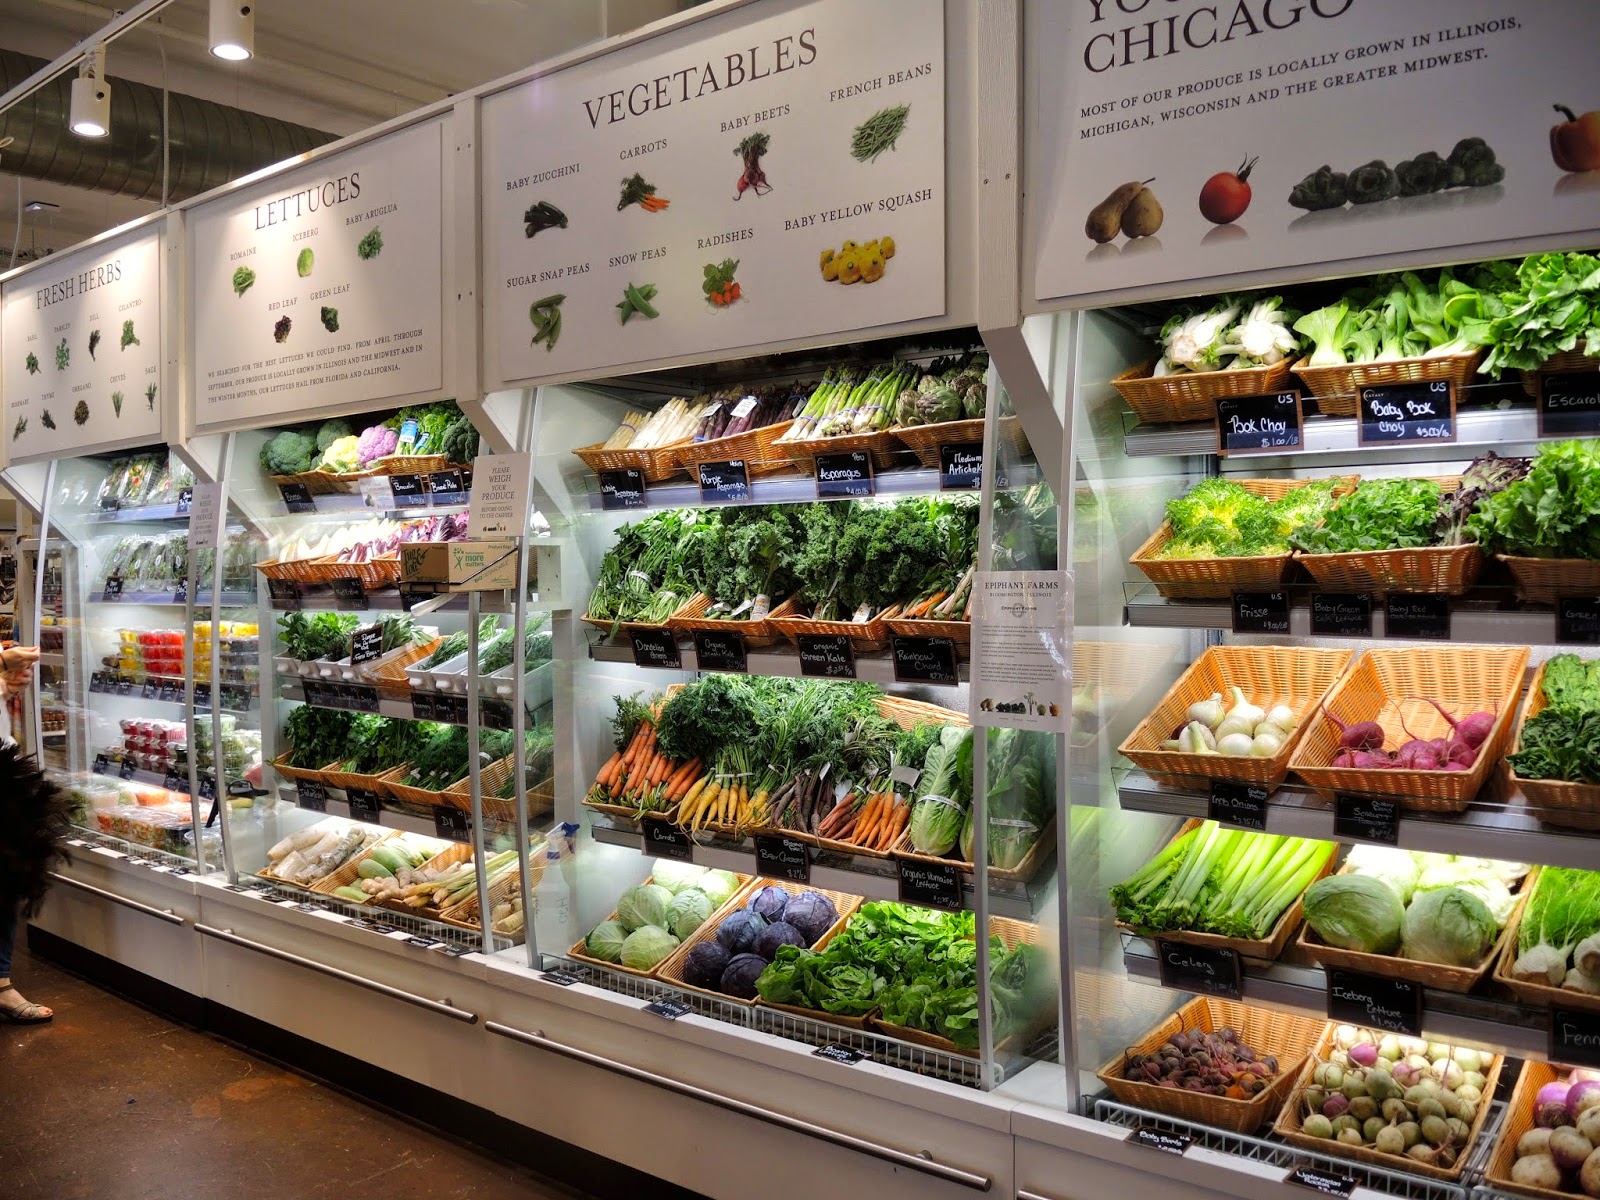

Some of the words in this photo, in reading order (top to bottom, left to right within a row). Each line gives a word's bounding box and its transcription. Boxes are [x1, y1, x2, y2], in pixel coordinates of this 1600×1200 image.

[1080, 101, 1117, 118] MOST
[1121, 96, 1139, 109] OF
[1143, 89, 1172, 104] OUR
[1177, 73, 1243, 97] PRODUCE
[1249, 70, 1262, 81] IS
[1268, 52, 1340, 76] LOCALLY
[1345, 39, 1405, 61] GROWN
[1412, 33, 1431, 47] IN
[1438, 17, 1522, 42] ILLINOIS,
[582, 28, 818, 130] VEGETABLES
[829, 77, 883, 102] FRENCH
[888, 63, 933, 86] BEANS
[1080, 115, 1154, 140] MICHIGAN,
[1160, 95, 1241, 122] WISCONSIN
[1246, 88, 1280, 104] AND
[1284, 80, 1318, 96] THE
[1323, 64, 1398, 89] GREATER
[1404, 47, 1488, 74] MIDWEST.
[720, 114, 750, 133] BABY
[753, 104, 791, 124] BEETS
[620, 139, 668, 161] CARROTS
[506, 175, 530, 191] BABY
[532, 163, 581, 185] ZUCCHINI
[254, 171, 361, 230] LETTUCES
[784, 215, 817, 232] BABY
[820, 202, 874, 226] YELLOW
[878, 189, 933, 213] SQUASH
[345, 213, 363, 226] BABY
[292, 227, 319, 242] ICEBERG
[697, 228, 754, 249] RADISHES
[230, 247, 257, 261] ROMAINE
[609, 253, 639, 269] SNOW
[641, 246, 667, 263] PEAS
[36, 277, 75, 309] FRESH
[78, 260, 122, 294] HERBS
[506, 273, 537, 288] SUGAR
[539, 268, 564, 283] SNAP
[566, 262, 590, 279] PEAS
[310, 288, 332, 301] GREEN
[333, 284, 350, 295] LEAF
[118, 299, 142, 312] CILANTRO
[268, 302, 281, 311] RED
[282, 297, 298, 308] LEAF
[265, 359, 277, 367] BEST
[279, 353, 304, 364] LETTUCES
[316, 347, 335, 357] COULD
[355, 340, 371, 349] FROM
[373, 335, 391, 345] APRIL
[393, 329, 423, 341] THROUGH
[145, 365, 157, 375] SAGE
[246, 373, 267, 384] PRODUCE
[273, 368, 295, 379] LOCALLY
[296, 364, 315, 374] GROWN
[323, 358, 347, 369] ILLINOIS
[348, 356, 360, 365] AND
[361, 354, 372, 362] THE
[374, 348, 400, 360] MIDWEST
[401, 345, 414, 354] AND
[415, 344, 423, 352] IN
[72, 383, 92, 393] OREGANO
[109, 373, 126, 383] CHIVES
[258, 386, 269, 395] OUR
[270, 382, 295, 393] LETTUCES
[295, 380, 308, 388] HAIL
[309, 378, 324, 386] FROM
[325, 374, 348, 383] FLORIDA
[350, 370, 362, 379] AND
[363, 364, 401, 376] CALIFORNIA.
[1370, 400, 1404, 420] Baby
[1260, 417, 1286, 435] Choy
[1379, 421, 1405, 437] Choy
[488, 474, 511, 483] WEIGH
[482, 491, 515, 500] PRODUCE
[827, 652, 846, 663] Kale
[1332, 986, 1374, 1005] Iceberg
